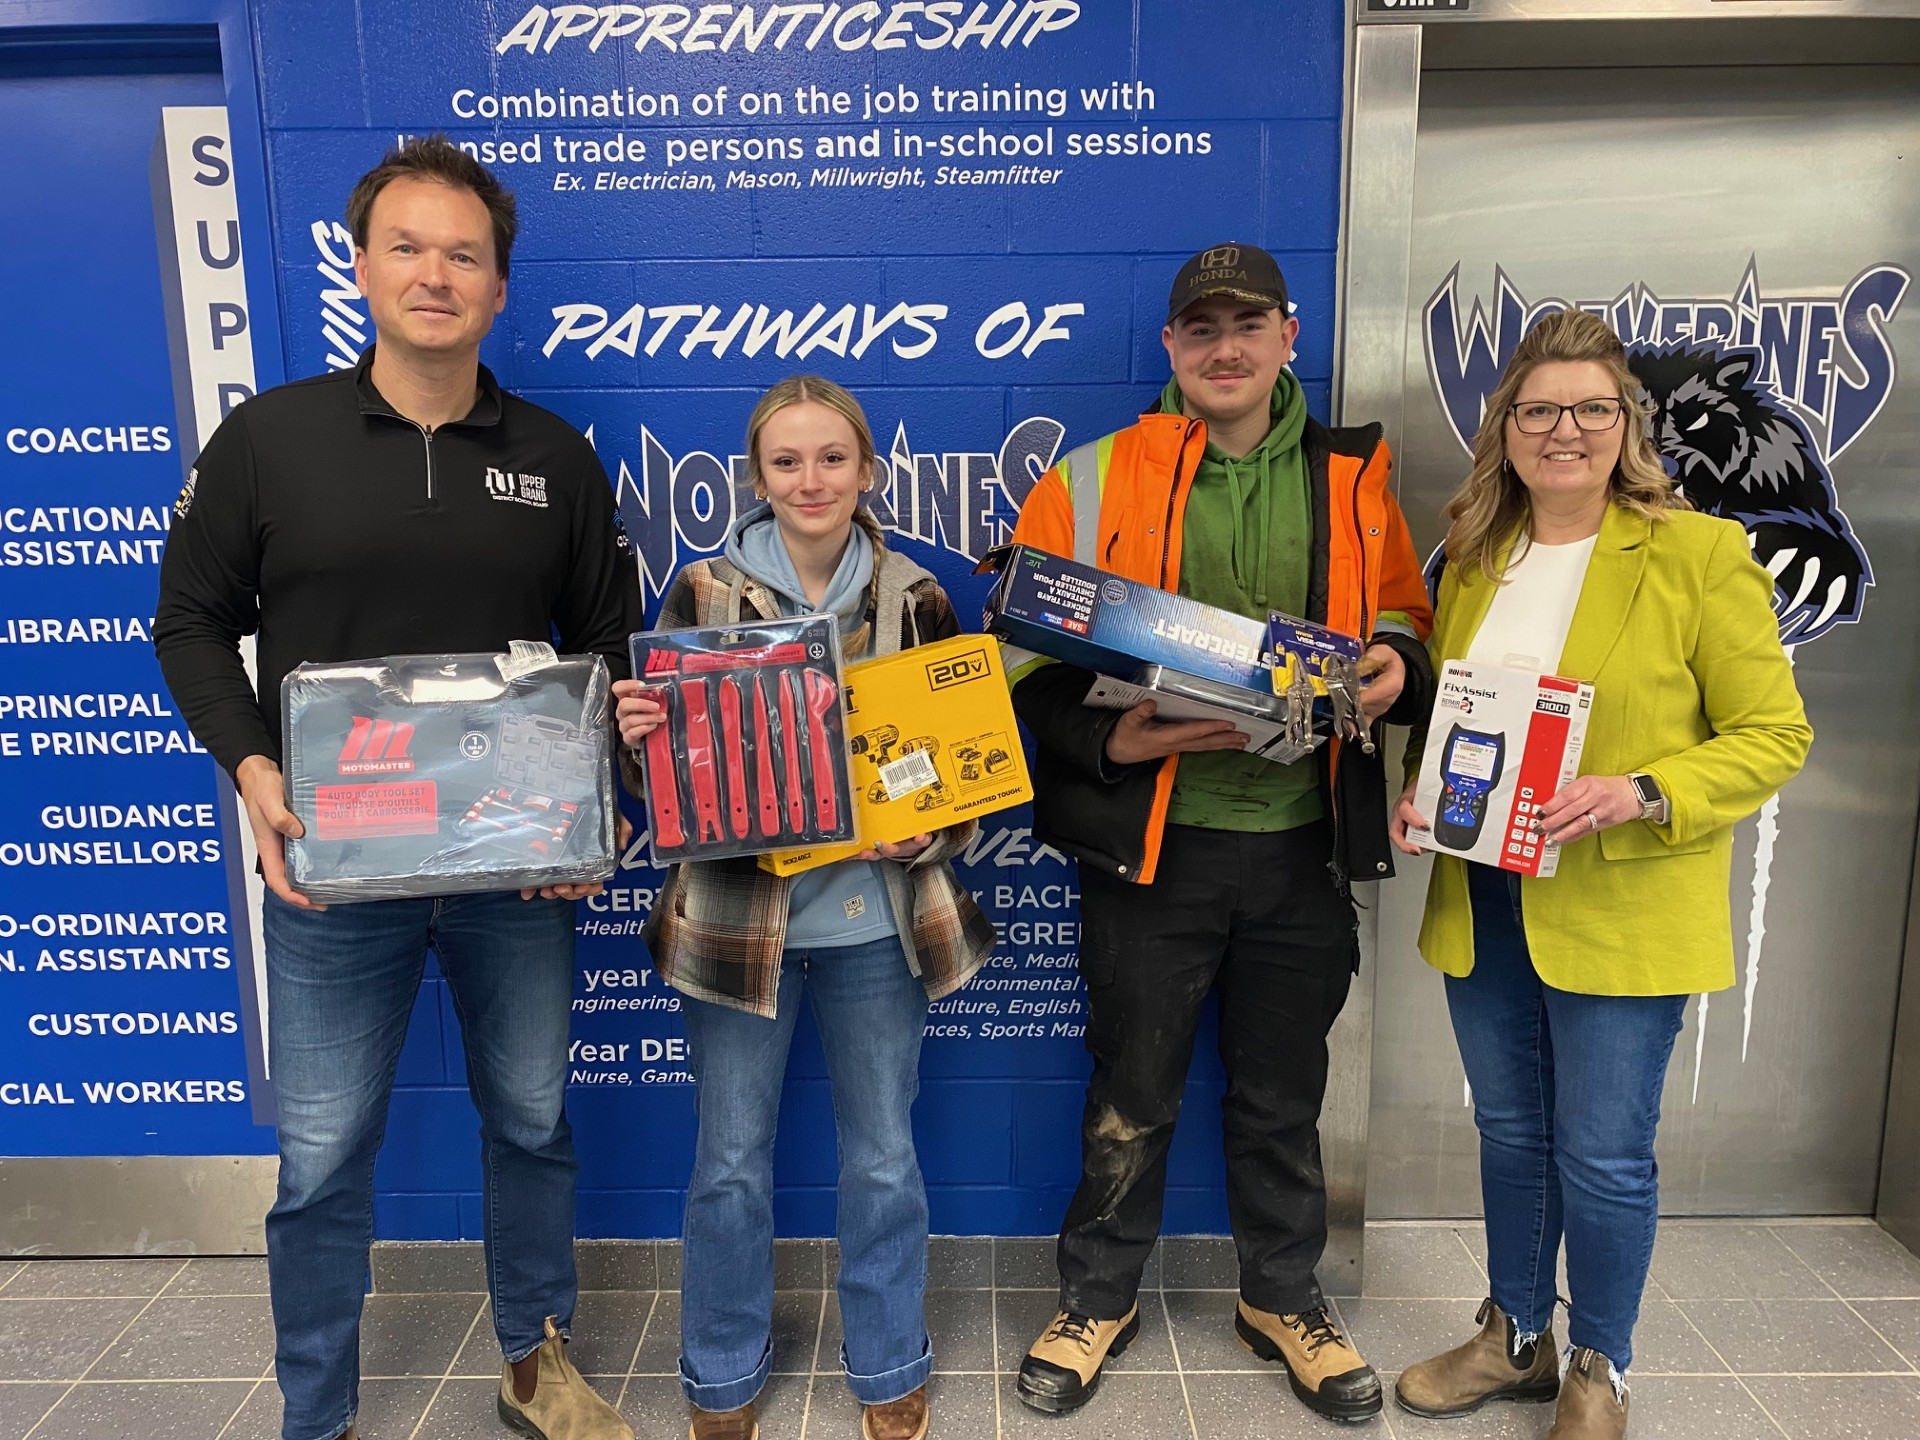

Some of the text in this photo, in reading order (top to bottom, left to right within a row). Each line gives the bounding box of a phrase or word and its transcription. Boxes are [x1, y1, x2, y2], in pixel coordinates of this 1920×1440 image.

[496, 0, 1080, 55] APPRENTICESHIP
[452, 82, 1154, 119] Combination of on the job training with
[397, 126, 1211, 167] lnsed trade persons and in-school sessions
[554, 165, 1063, 192] Ex. Electrician, Mason, Millwright, Steamfitter
[1189, 269, 1248, 287] HONDA
[543, 302, 1084, 361] PATHWAYS OF
[6, 426, 172, 454] COACHES
[519, 473, 546, 490] UPPER
[521, 486, 547, 502] GRAND
[0, 540, 163, 566] SSISTANT
[1033, 572, 1055, 586] POUR
[1061, 573, 1097, 590] DOUILLES
[1055, 580, 1096, 598] CHEVILLES
[1057, 588, 1093, 605] PLATEAUX
[1037, 591, 1091, 614] SOCKET TRAYS
[1067, 620, 1084, 631] SAE
[1074, 611, 1089, 622] PEG
[1444, 682, 1498, 700] FixAssist
[0, 694, 172, 719] PRINCIPAL
[1441, 697, 1461, 707] REPAIR
[31, 731, 207, 756] PRINCIPAL
[341, 762, 411, 773] MOTOMASTER
[327, 787, 426, 800] AUTO BODY TOOL SET
[324, 806, 430, 819] POUR LA CARROSSERIE
[334, 798, 420, 810] TROUSSE D'OUTILS
[953, 794, 997, 813] GUARANTEED
[41, 804, 215, 829] GUIDANCE
[36, 947, 231, 972] ASSISTANTS
[583, 968, 652, 992] year
[928, 999, 1080, 1017] culture, English
[28, 1011, 239, 1037] CUSTODIANS
[922, 1024, 972, 1039] nces,
[979, 1022, 1045, 1040] Sports
[568, 1039, 630, 1062] Year
[570, 1069, 633, 1087] Nurse,
[0, 1080, 247, 1105] CIAL WORKERS
